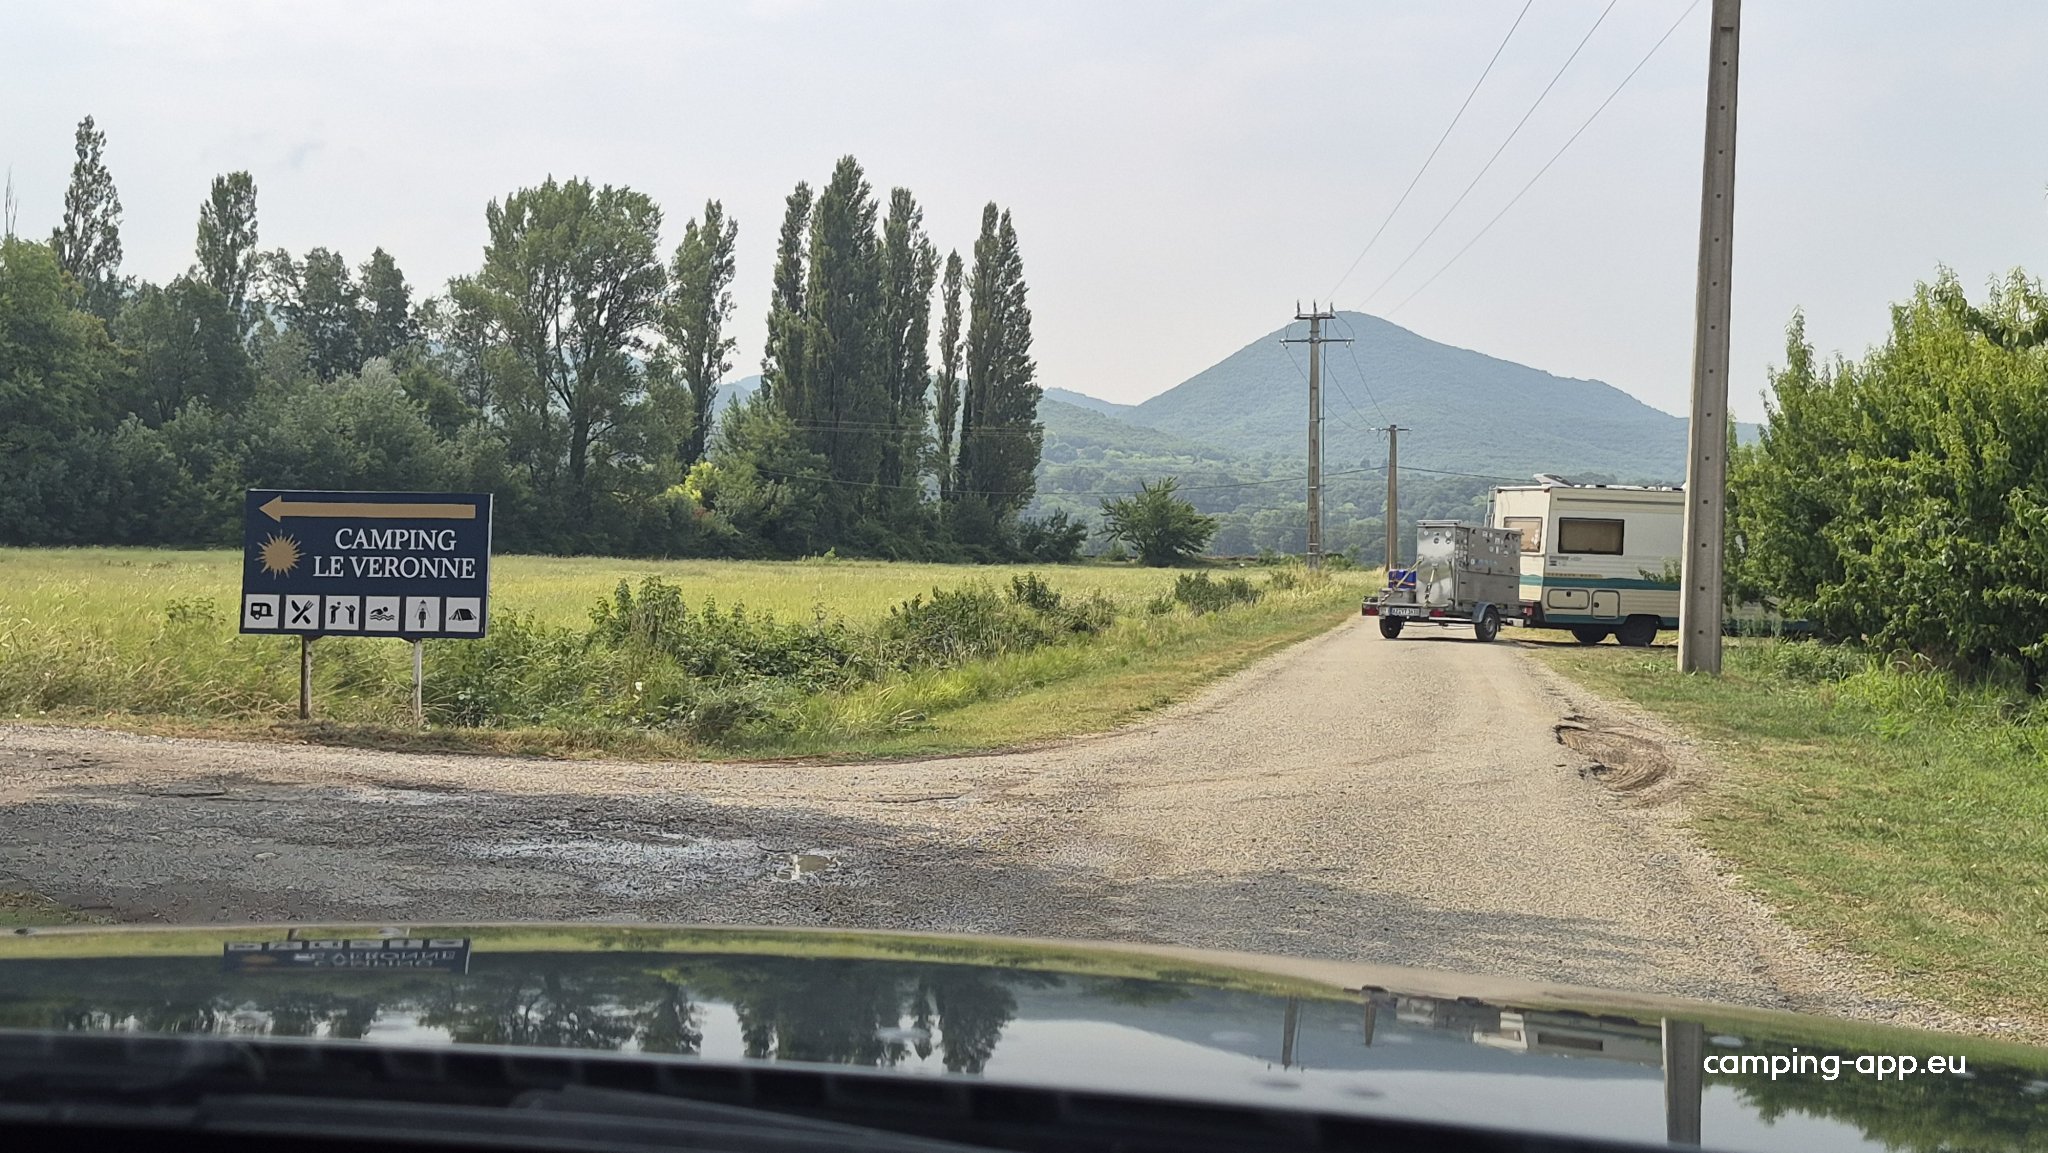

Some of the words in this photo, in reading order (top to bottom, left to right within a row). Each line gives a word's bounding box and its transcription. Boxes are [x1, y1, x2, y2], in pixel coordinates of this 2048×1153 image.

[334, 528, 457, 551] CAMPING
[313, 556, 344, 578] LE
[349, 556, 476, 579] VERONNE
